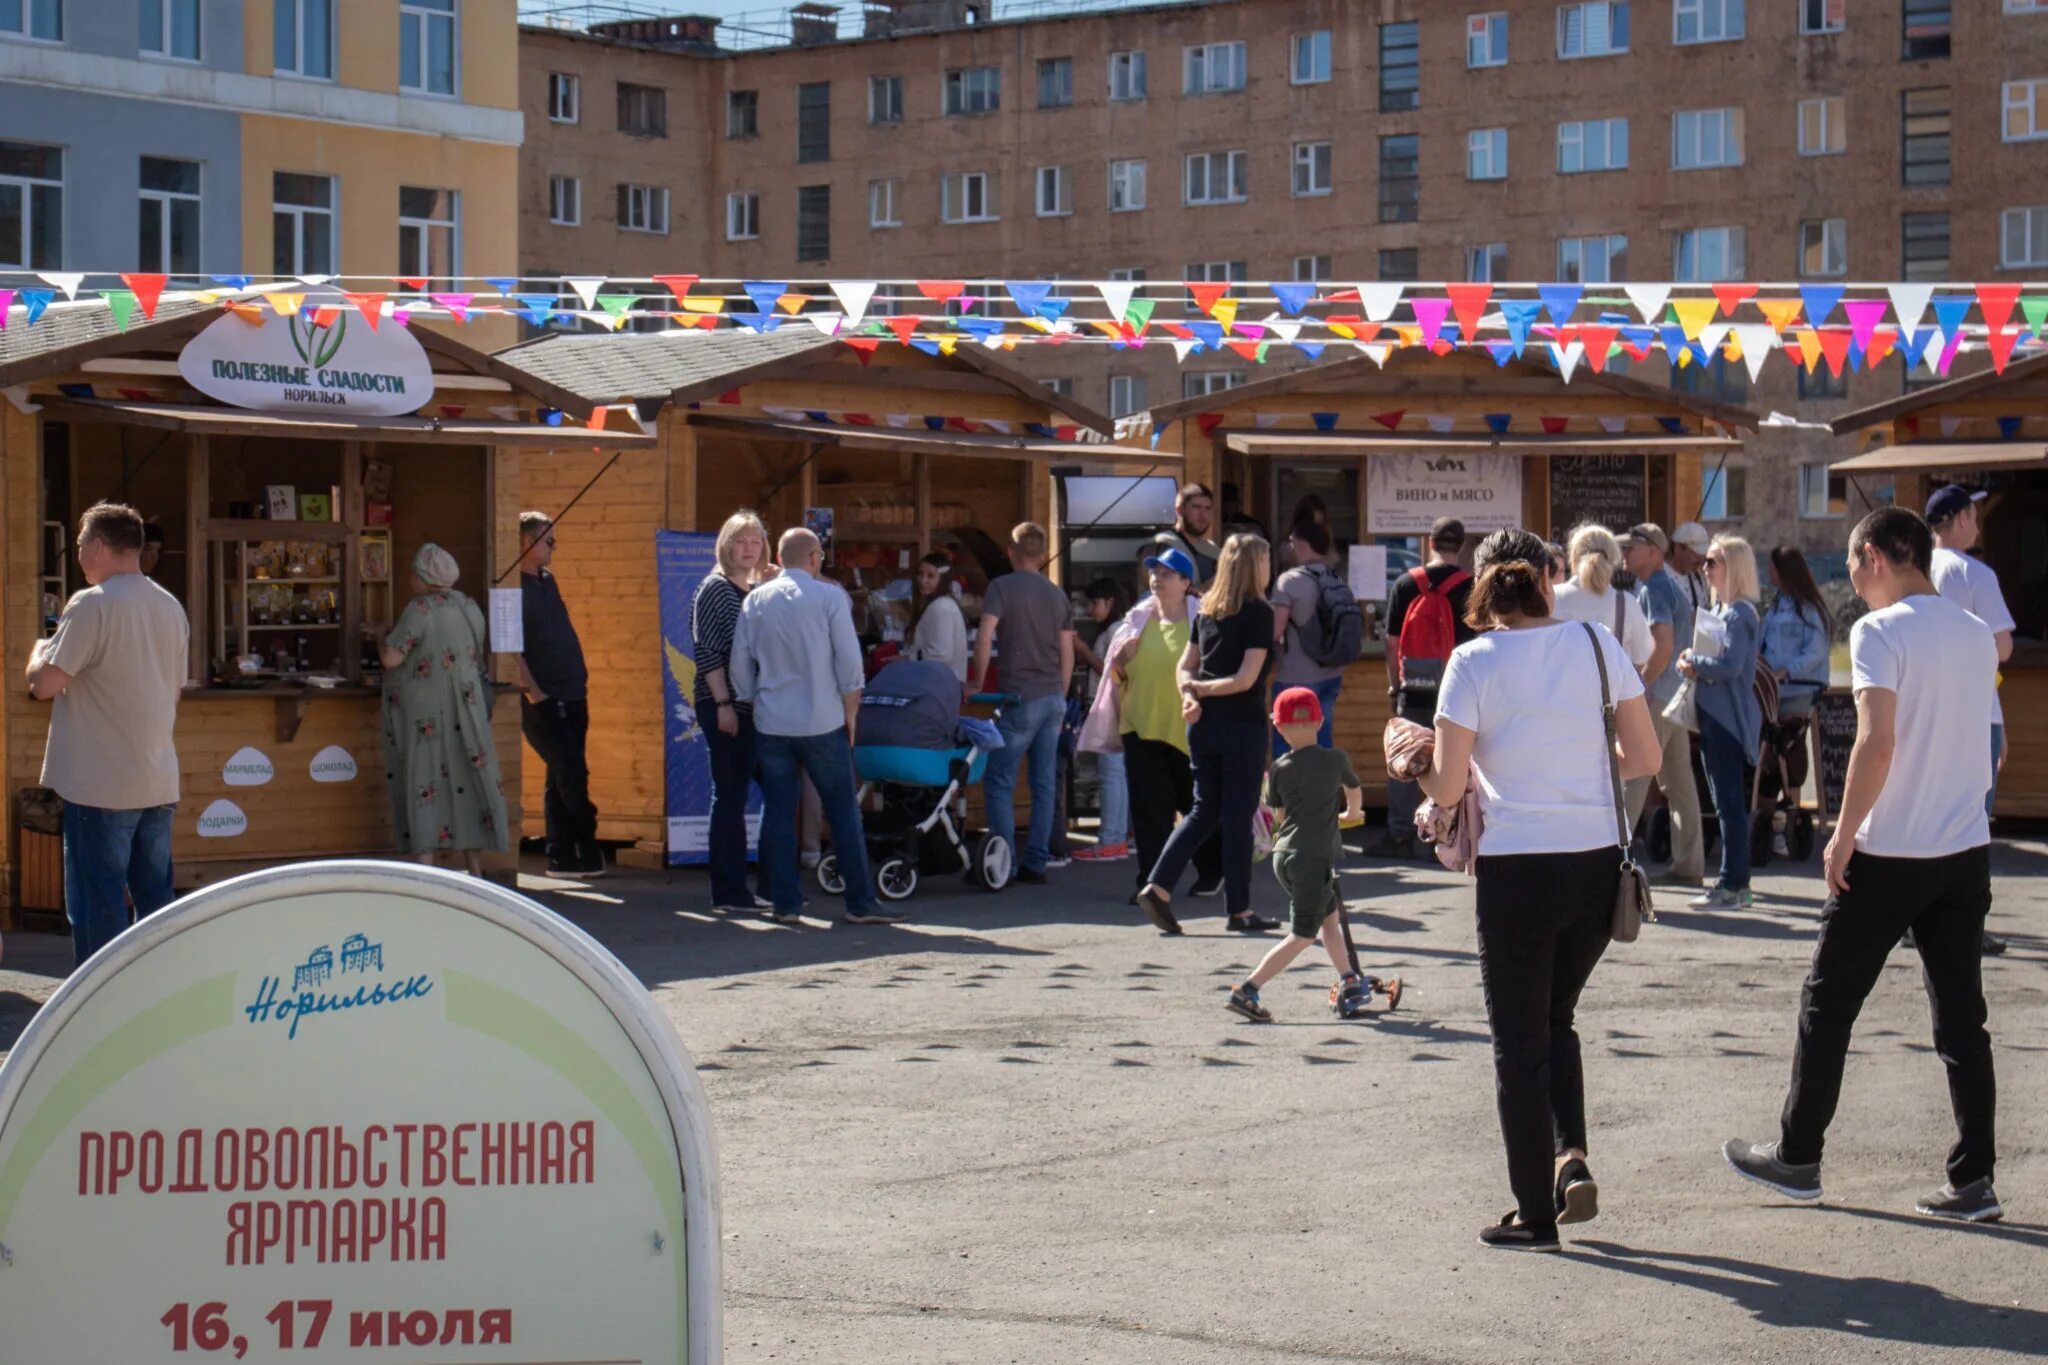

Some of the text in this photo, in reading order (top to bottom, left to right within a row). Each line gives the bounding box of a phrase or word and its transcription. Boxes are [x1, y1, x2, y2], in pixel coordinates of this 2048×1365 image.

[212, 359, 406, 394] ПОЛЕЗНЫЕ СЛАДОСТИ
[284, 387, 347, 405] НОРИЛЬСК
[1396, 488, 1437, 501] ВИНО
[1452, 488, 1494, 501] МЯСО
[225, 764, 273, 775] МАРМЕЛАД
[312, 762, 354, 773] ШОКОЛАД
[200, 816, 244, 829] ПОДАРКИ
[246, 975, 434, 1040] Норильск
[78, 1120, 595, 1196] ПРОДОВОЛЬСТВЕННАЯ
[226, 1197, 446, 1266] ЯРМАРКА
[160, 1301, 513, 1359] 16, 17 июля
